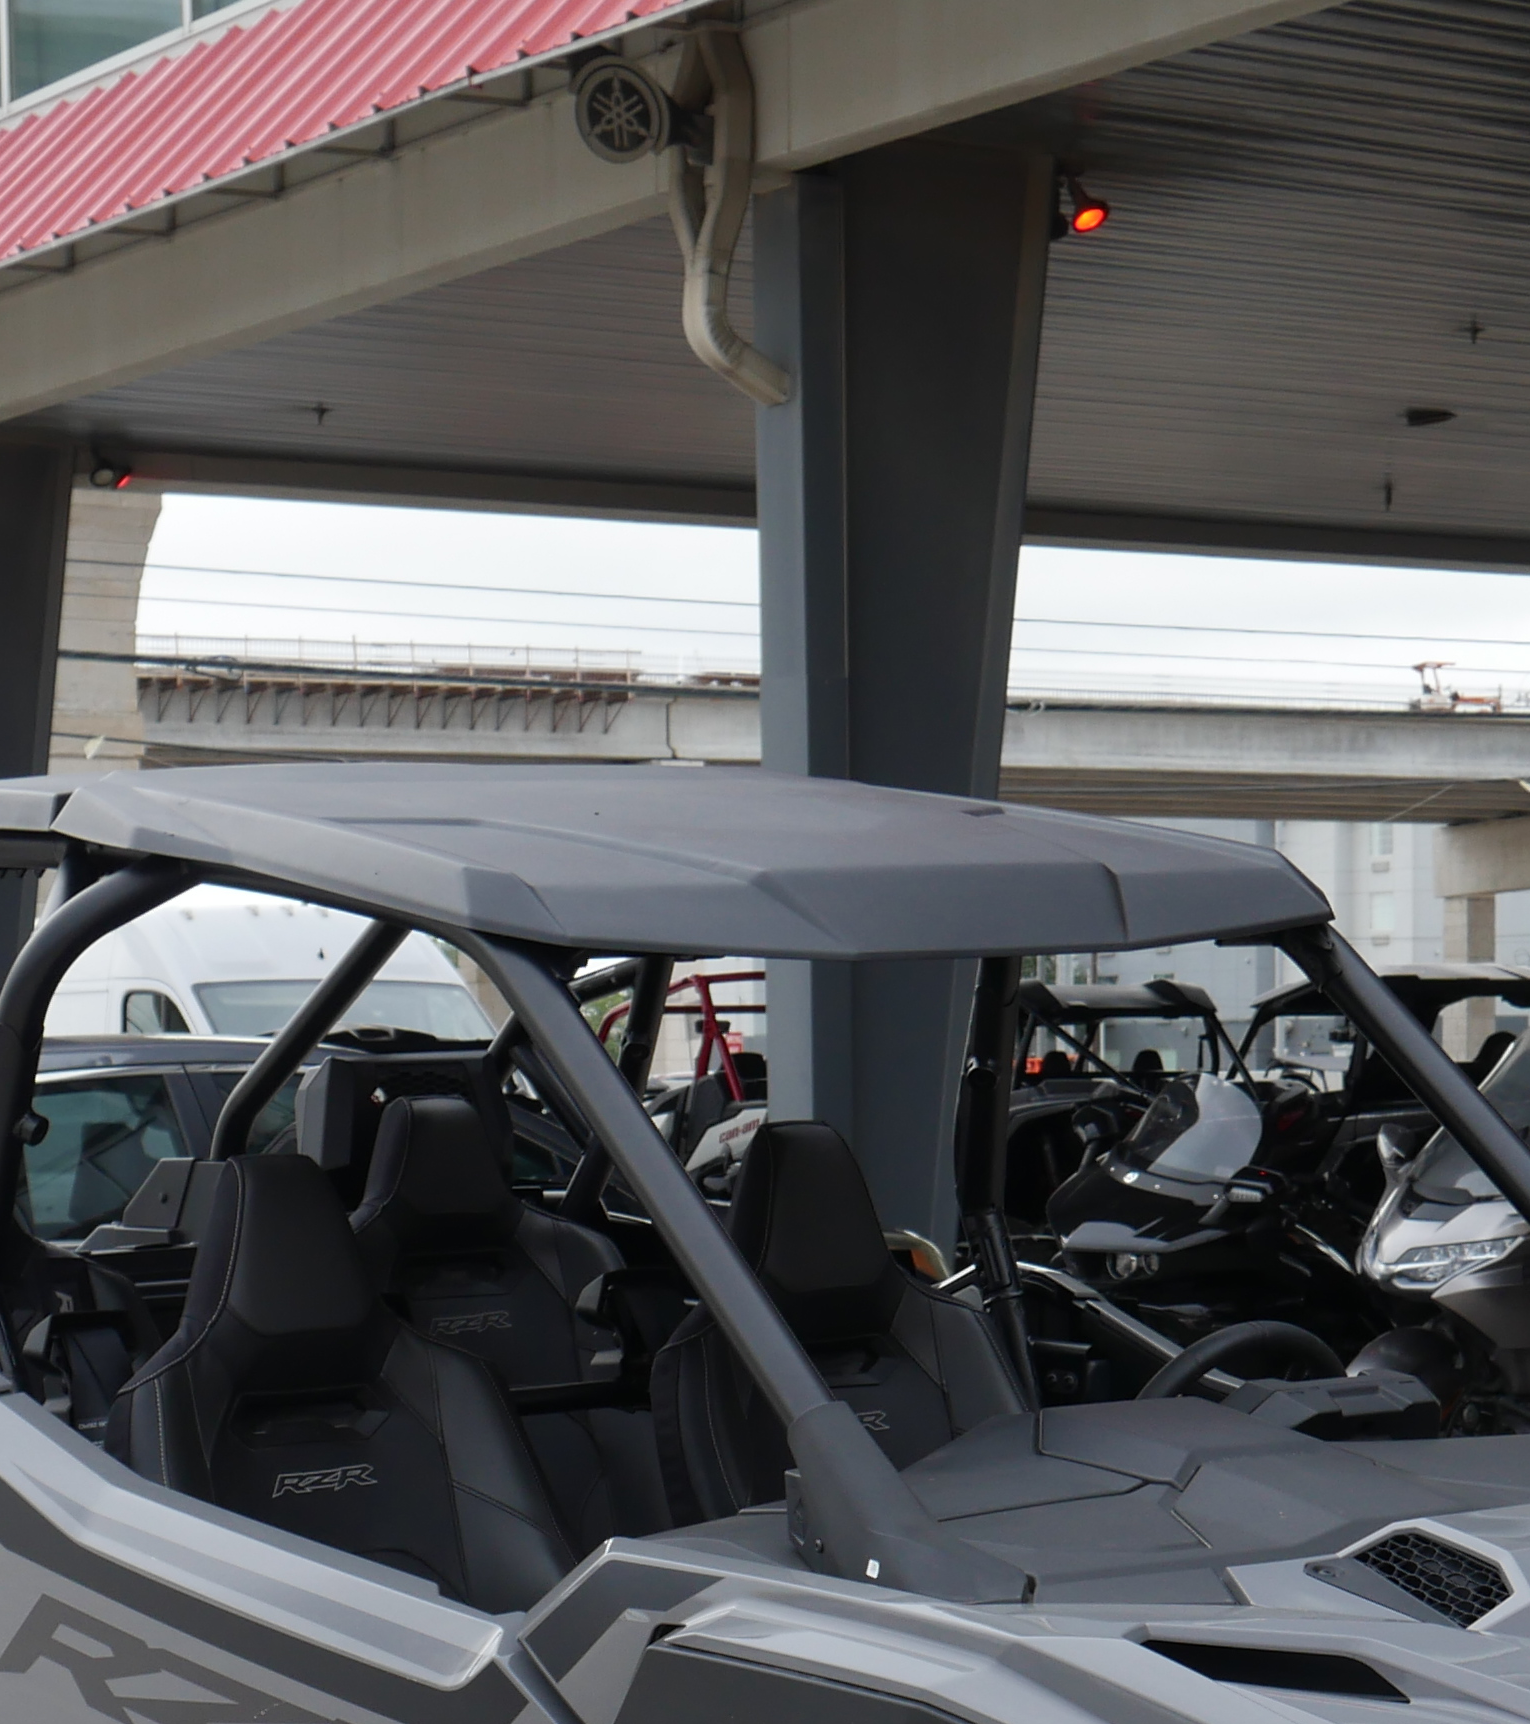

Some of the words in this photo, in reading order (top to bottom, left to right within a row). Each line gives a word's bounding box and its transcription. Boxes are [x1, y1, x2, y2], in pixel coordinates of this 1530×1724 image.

[719, 1117, 760, 1144] can-am
[430, 1309, 513, 1337] RZR
[272, 1463, 378, 1498] RZR
